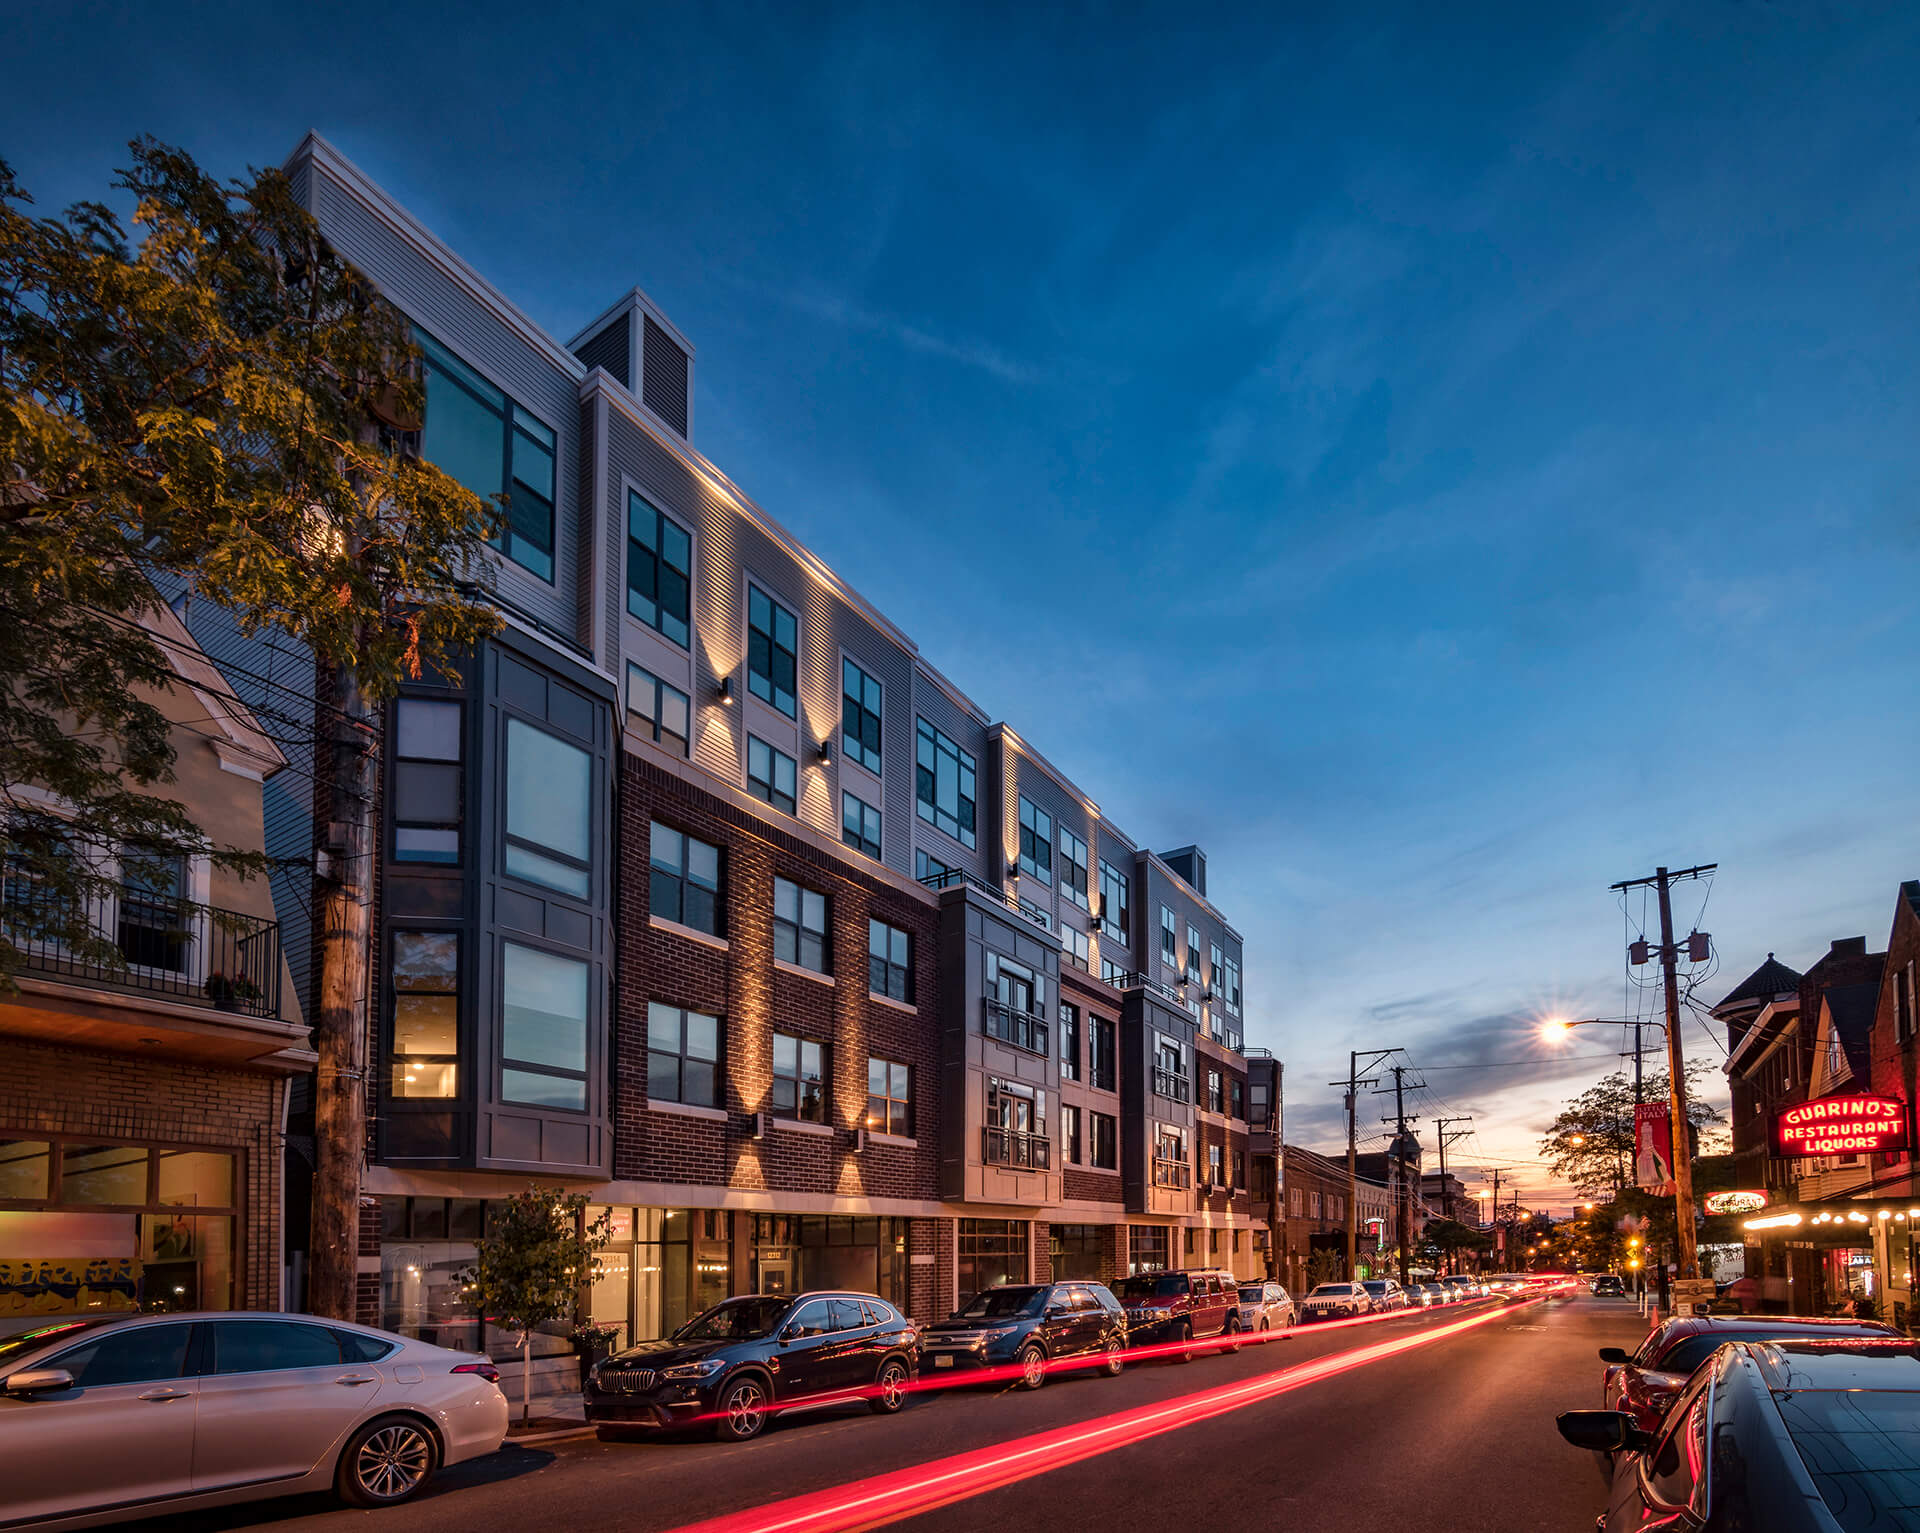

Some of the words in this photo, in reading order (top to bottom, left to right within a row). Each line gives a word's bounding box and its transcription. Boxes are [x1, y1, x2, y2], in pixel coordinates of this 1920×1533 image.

[1639, 1110, 1666, 1119] ITALY
[1640, 1105, 1666, 1113] LITTLE
[1783, 1120, 1902, 1141] RESTAURANT
[1805, 1136, 1878, 1152] LIQUORS
